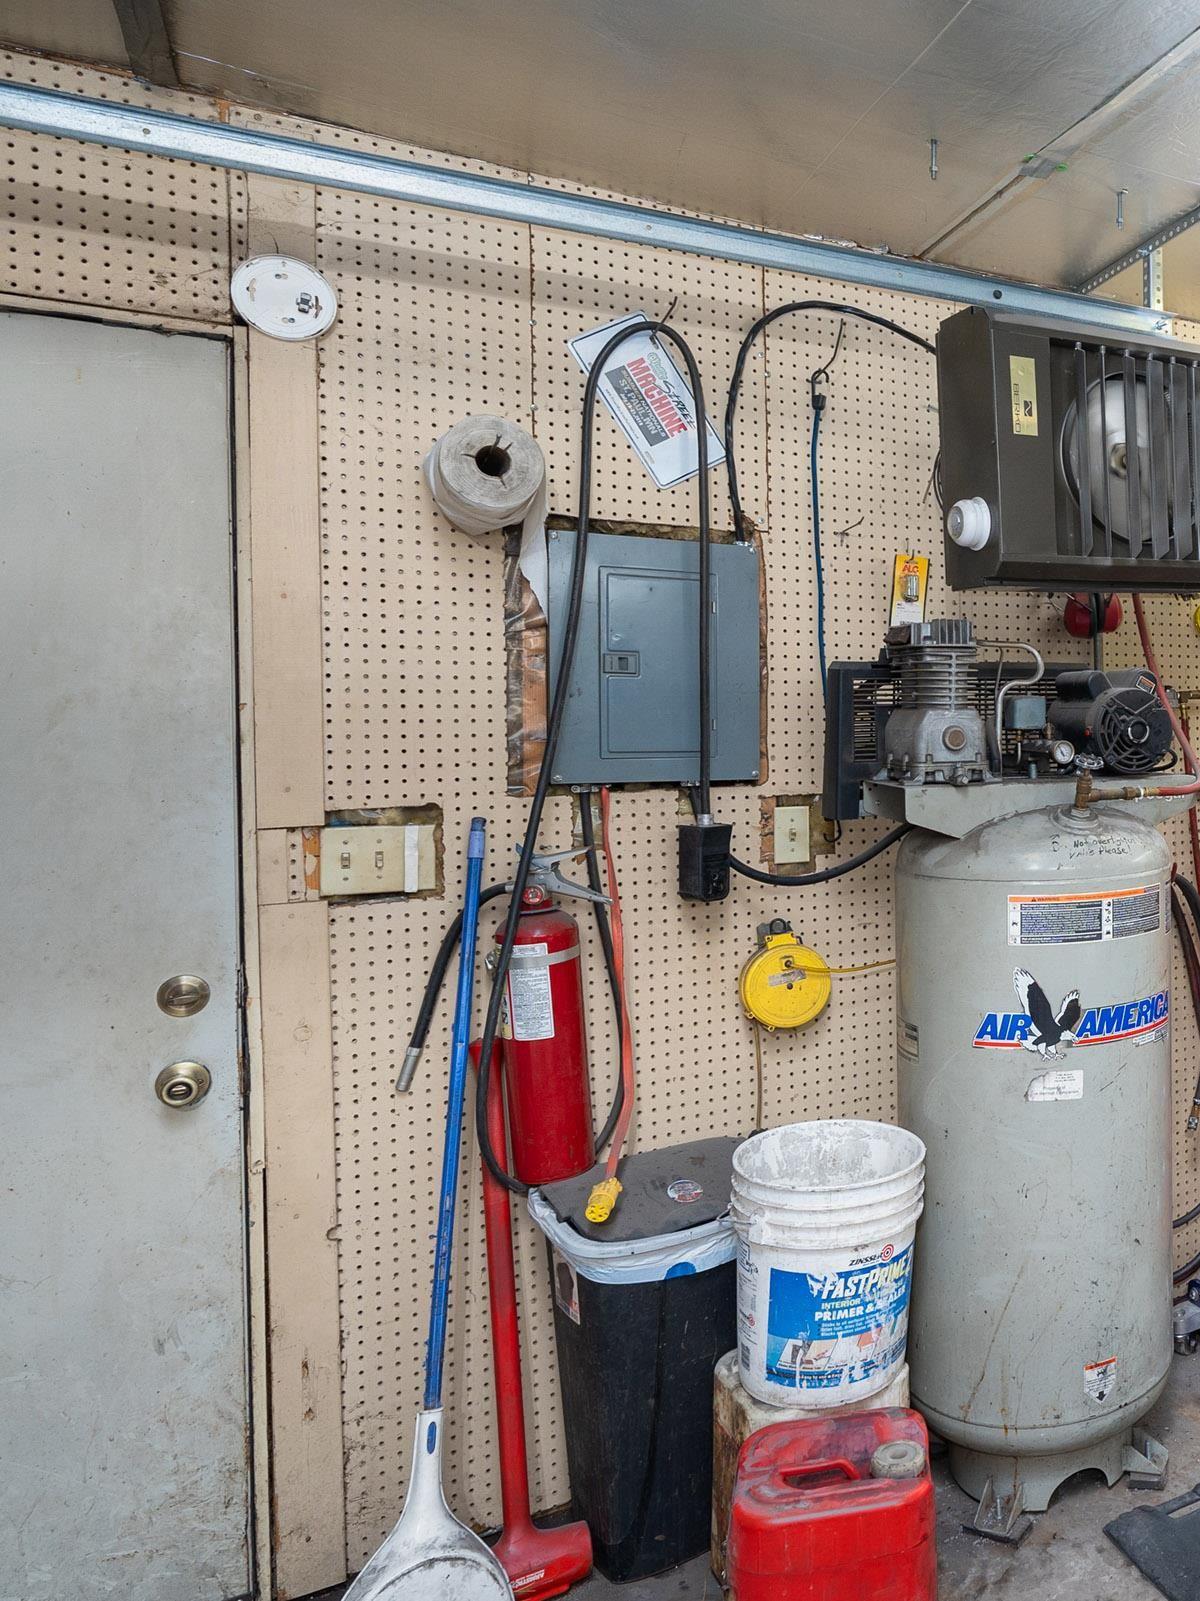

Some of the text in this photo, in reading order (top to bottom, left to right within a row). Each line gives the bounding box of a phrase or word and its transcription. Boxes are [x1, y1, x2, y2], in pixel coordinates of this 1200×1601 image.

[626, 357, 688, 437] MACHINE
[641, 400, 665, 437] NATIONALS
[975, 990, 1169, 1041] AIR AMERICA
[814, 1306, 864, 1322] PRIMER
[821, 1299, 861, 1310] INTERIOR
